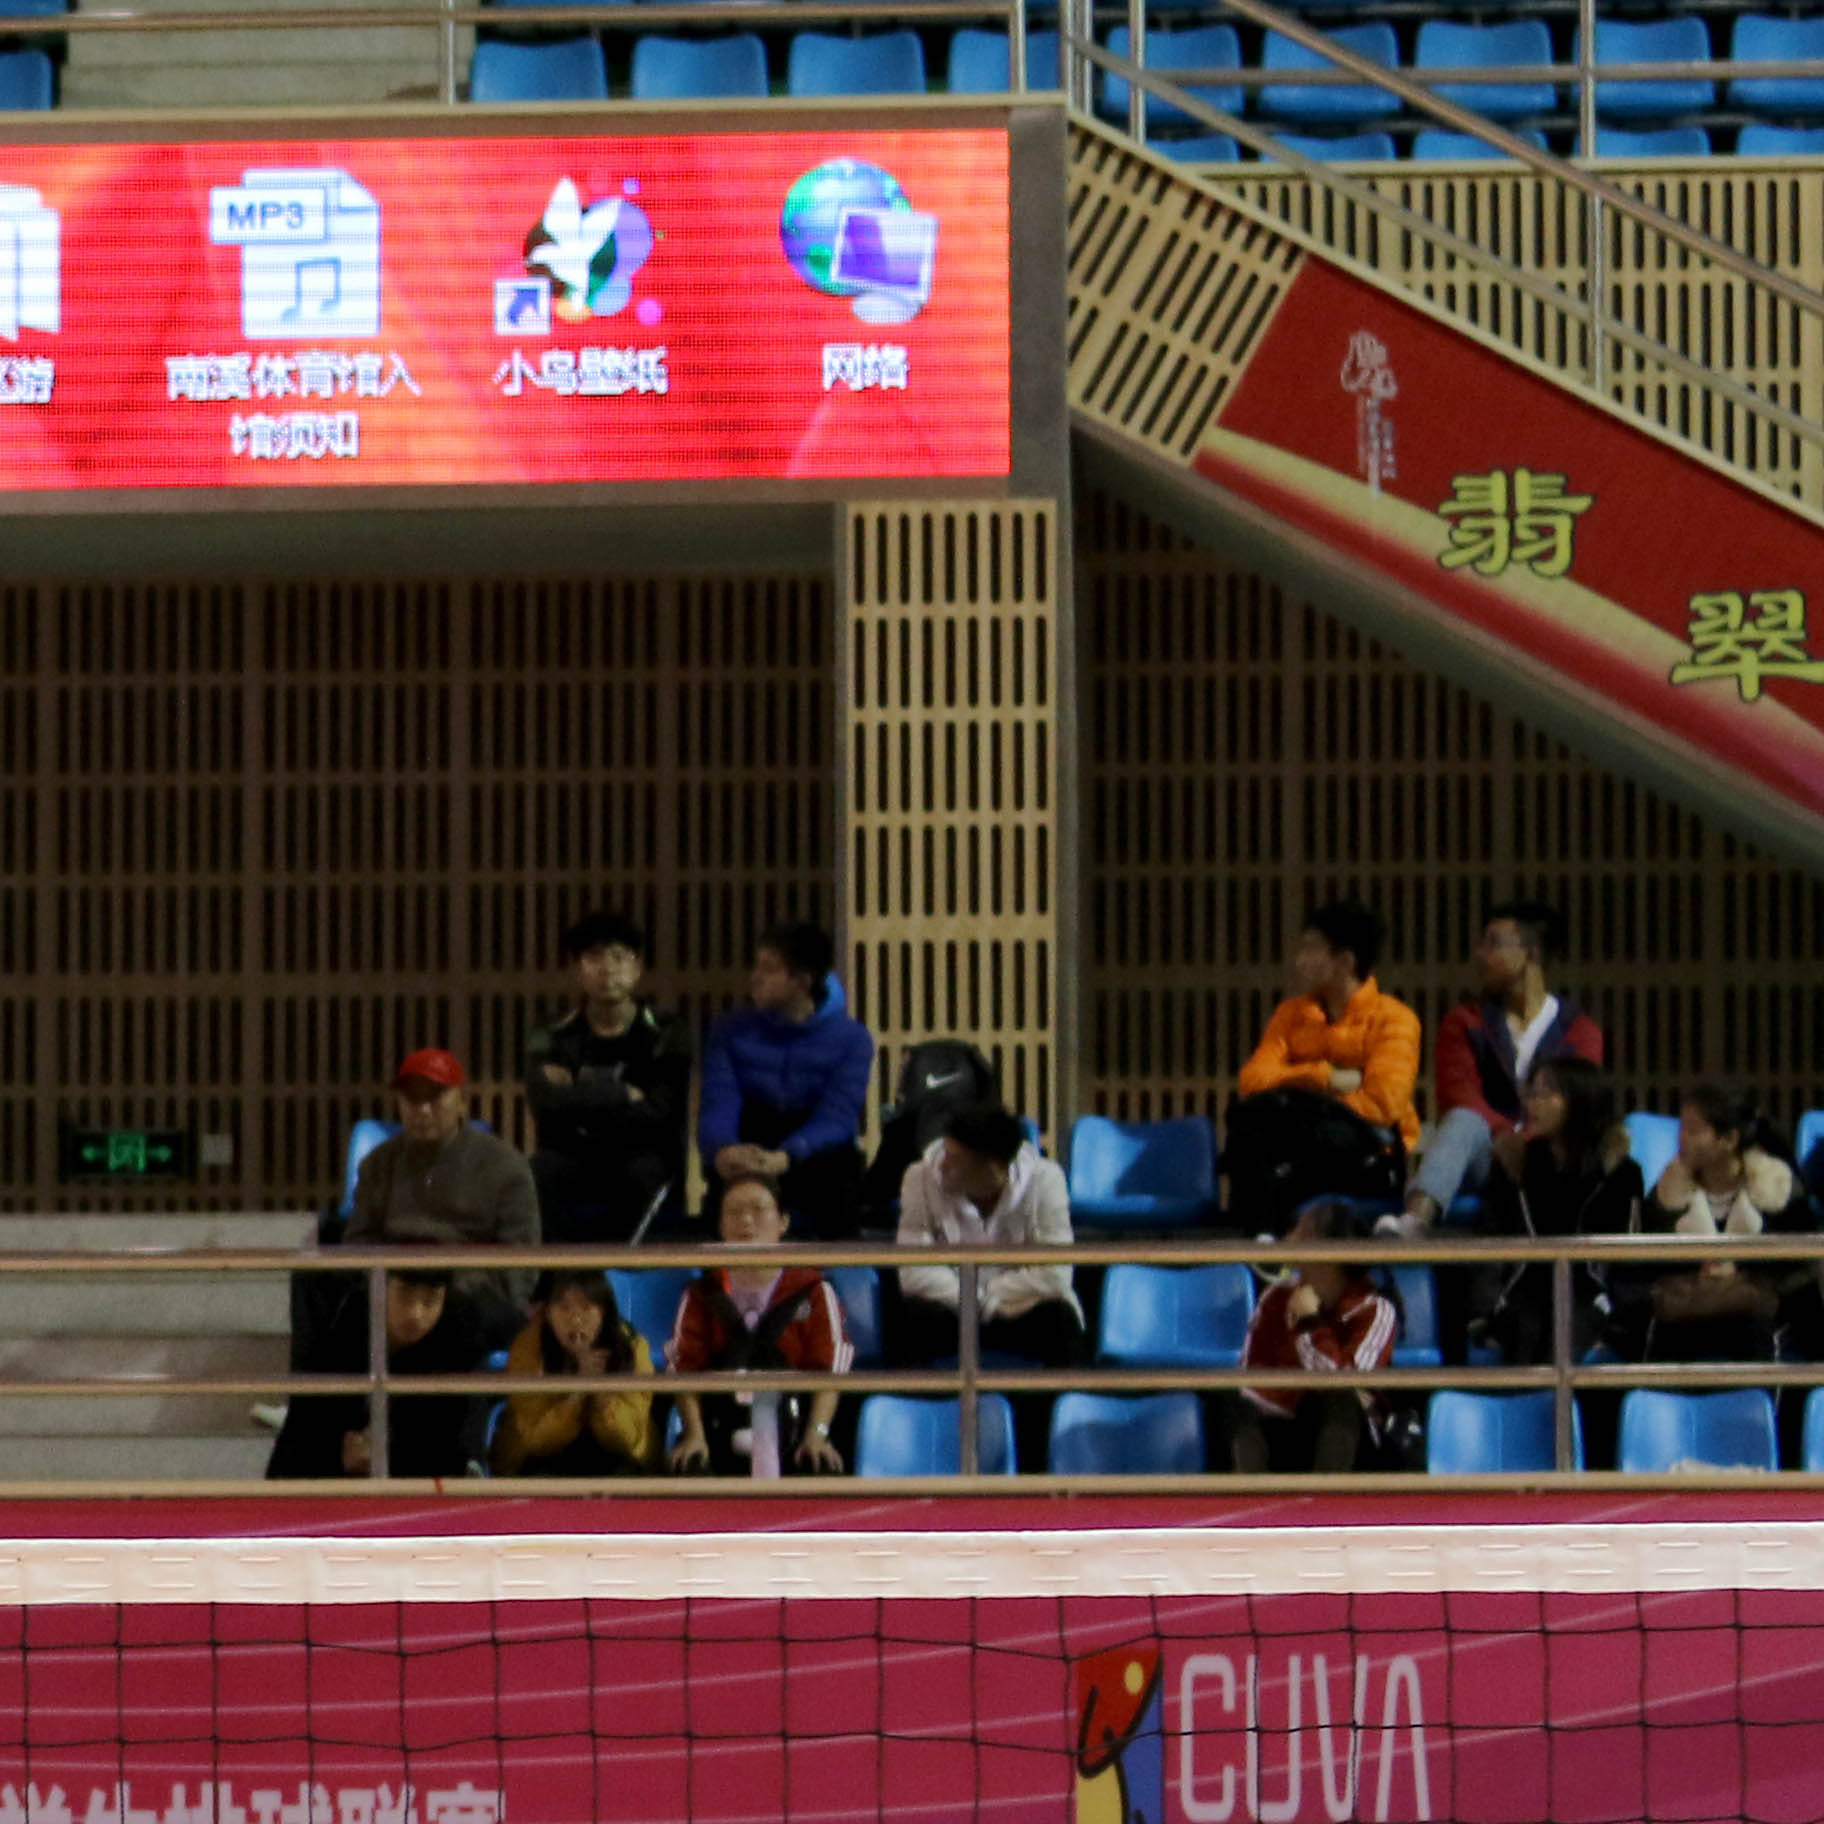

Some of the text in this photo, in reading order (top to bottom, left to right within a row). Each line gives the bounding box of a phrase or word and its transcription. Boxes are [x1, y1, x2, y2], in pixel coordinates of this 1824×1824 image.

[226, 202, 306, 229] MP3
[822, 343, 909, 391] 网络
[1180, 1653, 1431, 1824] CUVA
